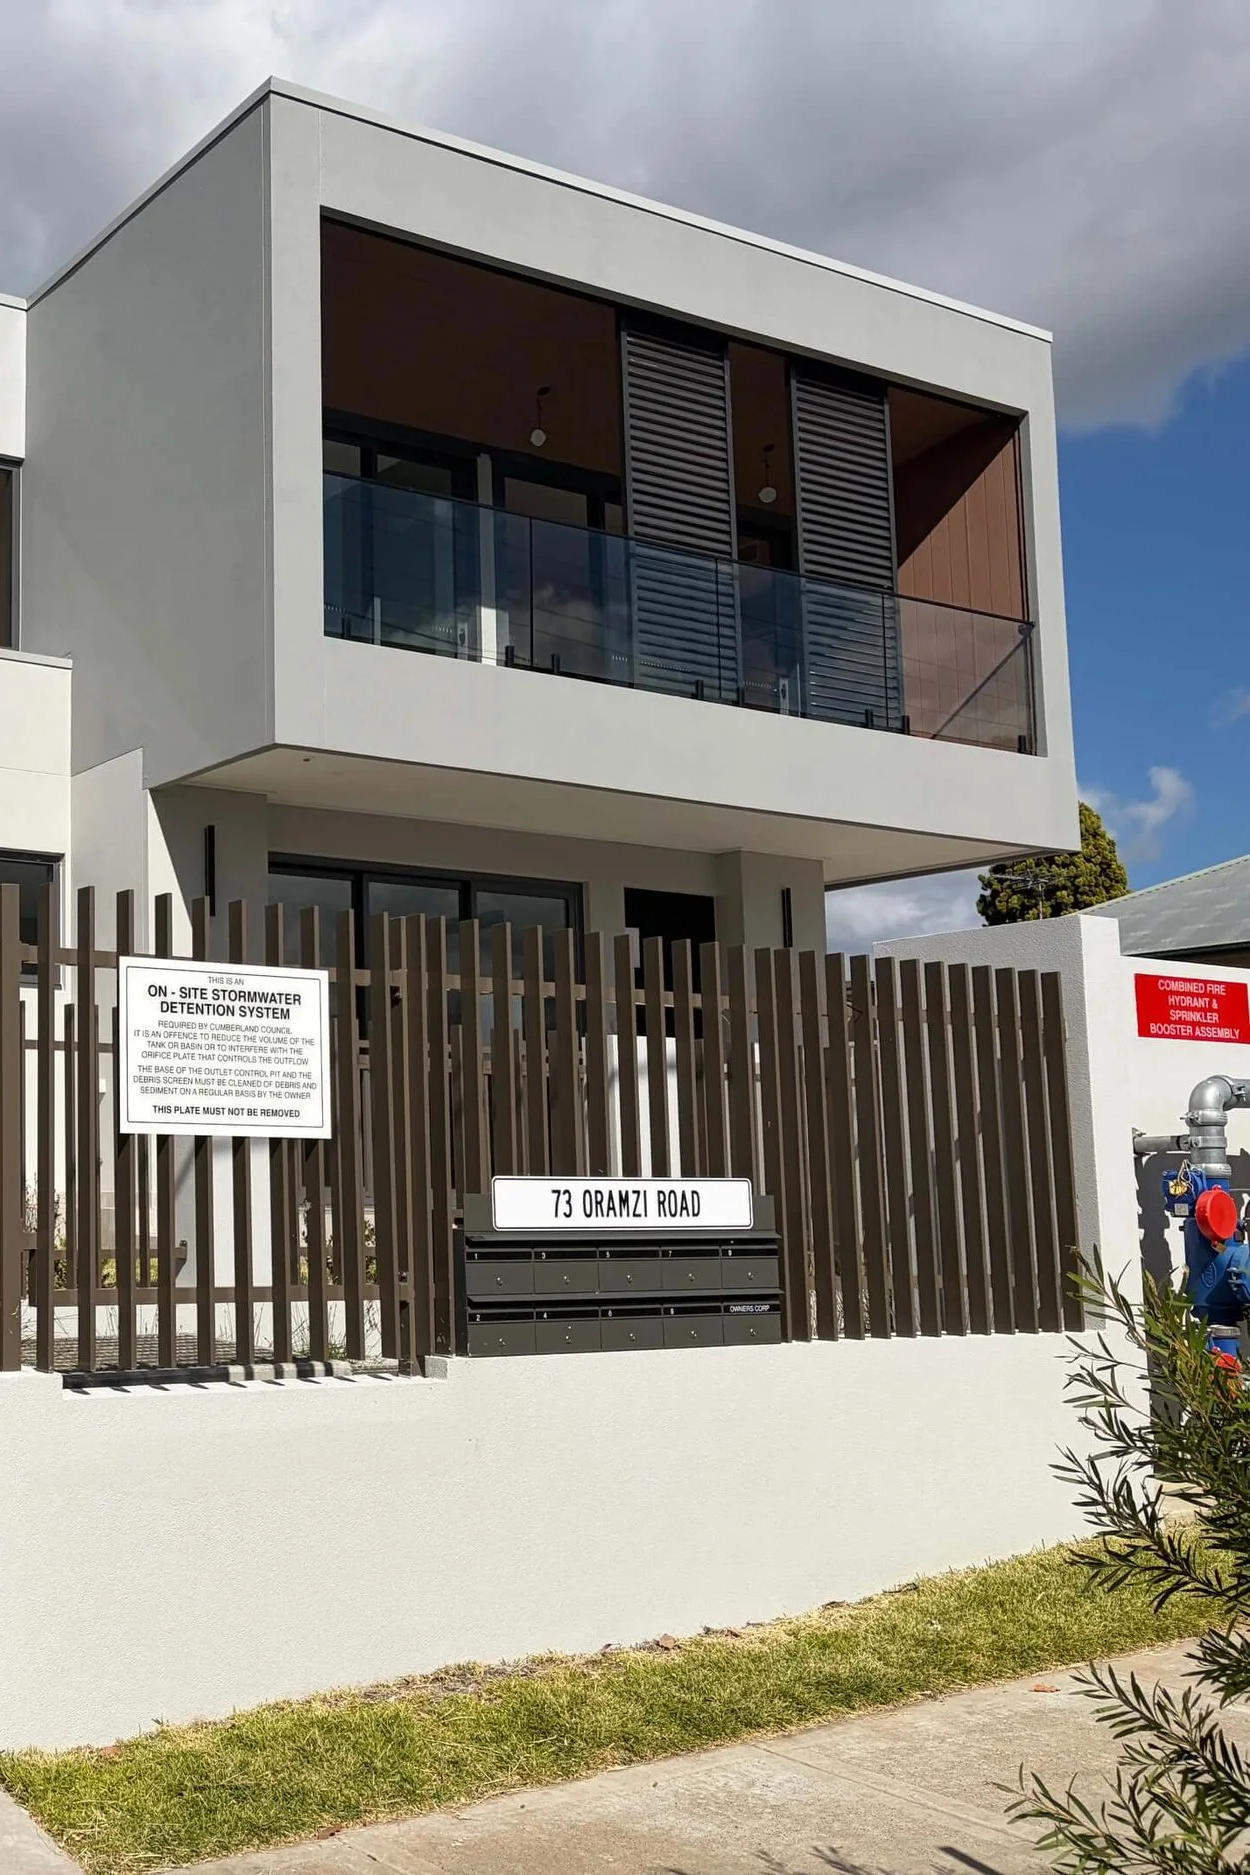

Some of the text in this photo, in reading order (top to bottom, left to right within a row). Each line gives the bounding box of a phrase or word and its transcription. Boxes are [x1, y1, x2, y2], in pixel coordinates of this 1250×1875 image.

[1158, 979, 1226, 995] COMBINED FIRE
[148, 985, 167, 997] ON
[179, 986, 208, 1000] SITE
[212, 989, 301, 1005] STORMWATER
[1168, 995, 1218, 1009] HYDRANT &
[160, 1001, 290, 1019] DETENTION SYSTEM
[1170, 1010, 1219, 1023] SPRINKLER
[158, 1020, 196, 1029] REQUIRED
[210, 1023, 259, 1033] CUMBERLAND
[261, 1026, 292, 1035] COUNCIL
[1150, 1023, 1240, 1039] BOOSTER ASSEMBLY
[163, 1031, 198, 1040] OFFENCE
[212, 1033, 241, 1042] REDUCE
[243, 1035, 256, 1043] THE
[258, 1036, 288, 1044] VOLUME
[147, 1041, 166, 1049] TANK
[181, 1042, 202, 1050] BASIN
[229, 1045, 268, 1053] INTERFERE
[141, 1051, 171, 1059] ORIFICE
[217, 1055, 256, 1063] CONTROLS
[258, 1056, 272, 1064] THE
[274, 1057, 308, 1065] OUTFLOW
[204, 1068, 232, 1076] OUTLET
[234, 1069, 268, 1078] CONTROL
[133, 1076, 160, 1084] DEBRIS
[163, 1077, 192, 1085] SCREEN
[195, 1078, 215, 1086] MUST
[228, 1079, 261, 1088] CLEANED
[275, 1081, 300, 1089] DEBRIS
[302, 1082, 317, 1090] AND
[140, 1086, 178, 1095] SEDIMENT
[199, 1089, 233, 1097] REGULAR
[235, 1090, 255, 1098] BASIS
[152, 1105, 300, 1118] THIS PLATE MUST NOT BE REMOVED
[552, 1189, 700, 1218] 73 ORAMZI ROAD
